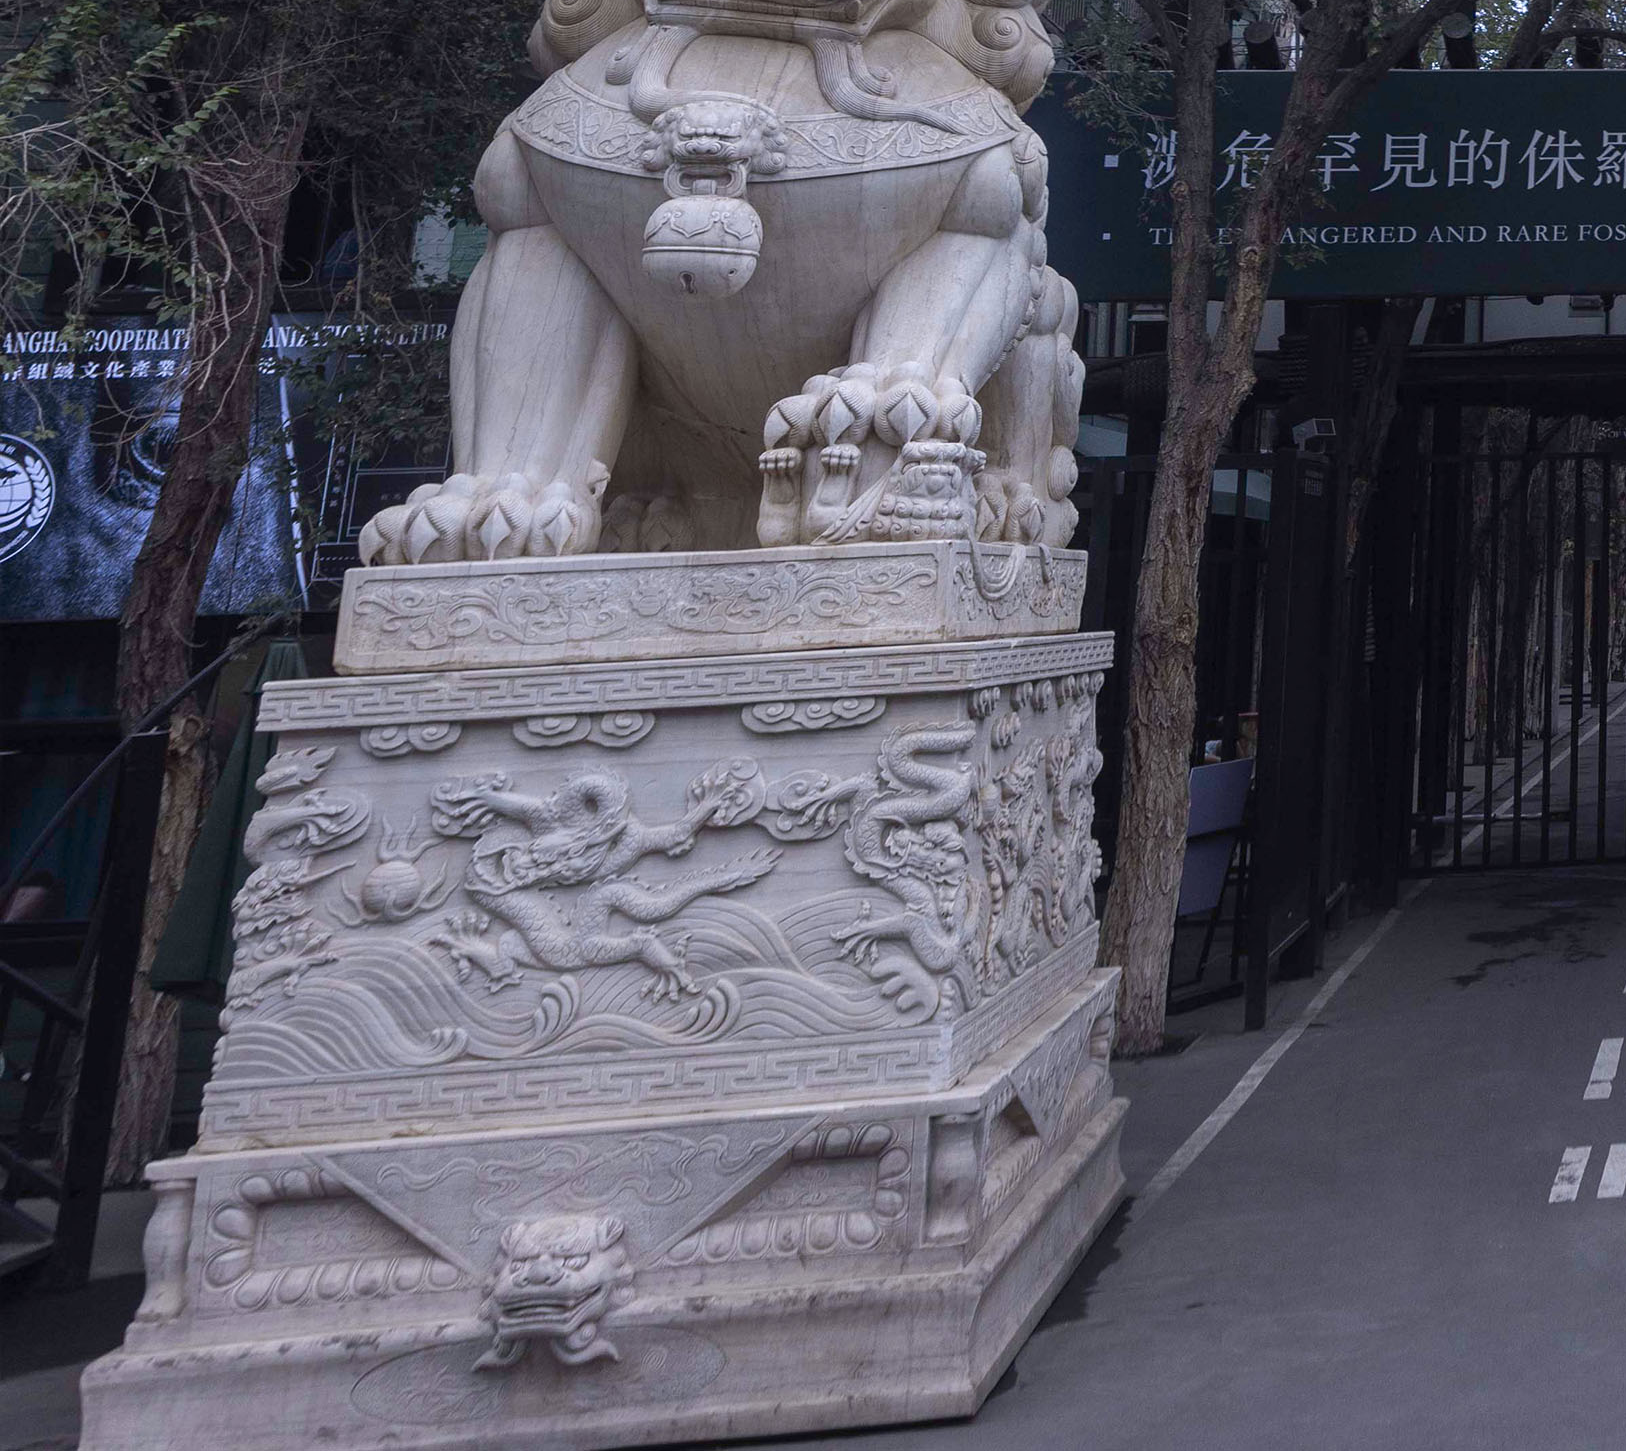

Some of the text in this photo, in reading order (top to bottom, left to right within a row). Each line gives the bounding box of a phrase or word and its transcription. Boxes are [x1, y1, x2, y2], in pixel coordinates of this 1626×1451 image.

[1218, 226, 1417, 245] EANGERED
[1427, 226, 1487, 243] AND
[1497, 225, 1569, 242] RARE
